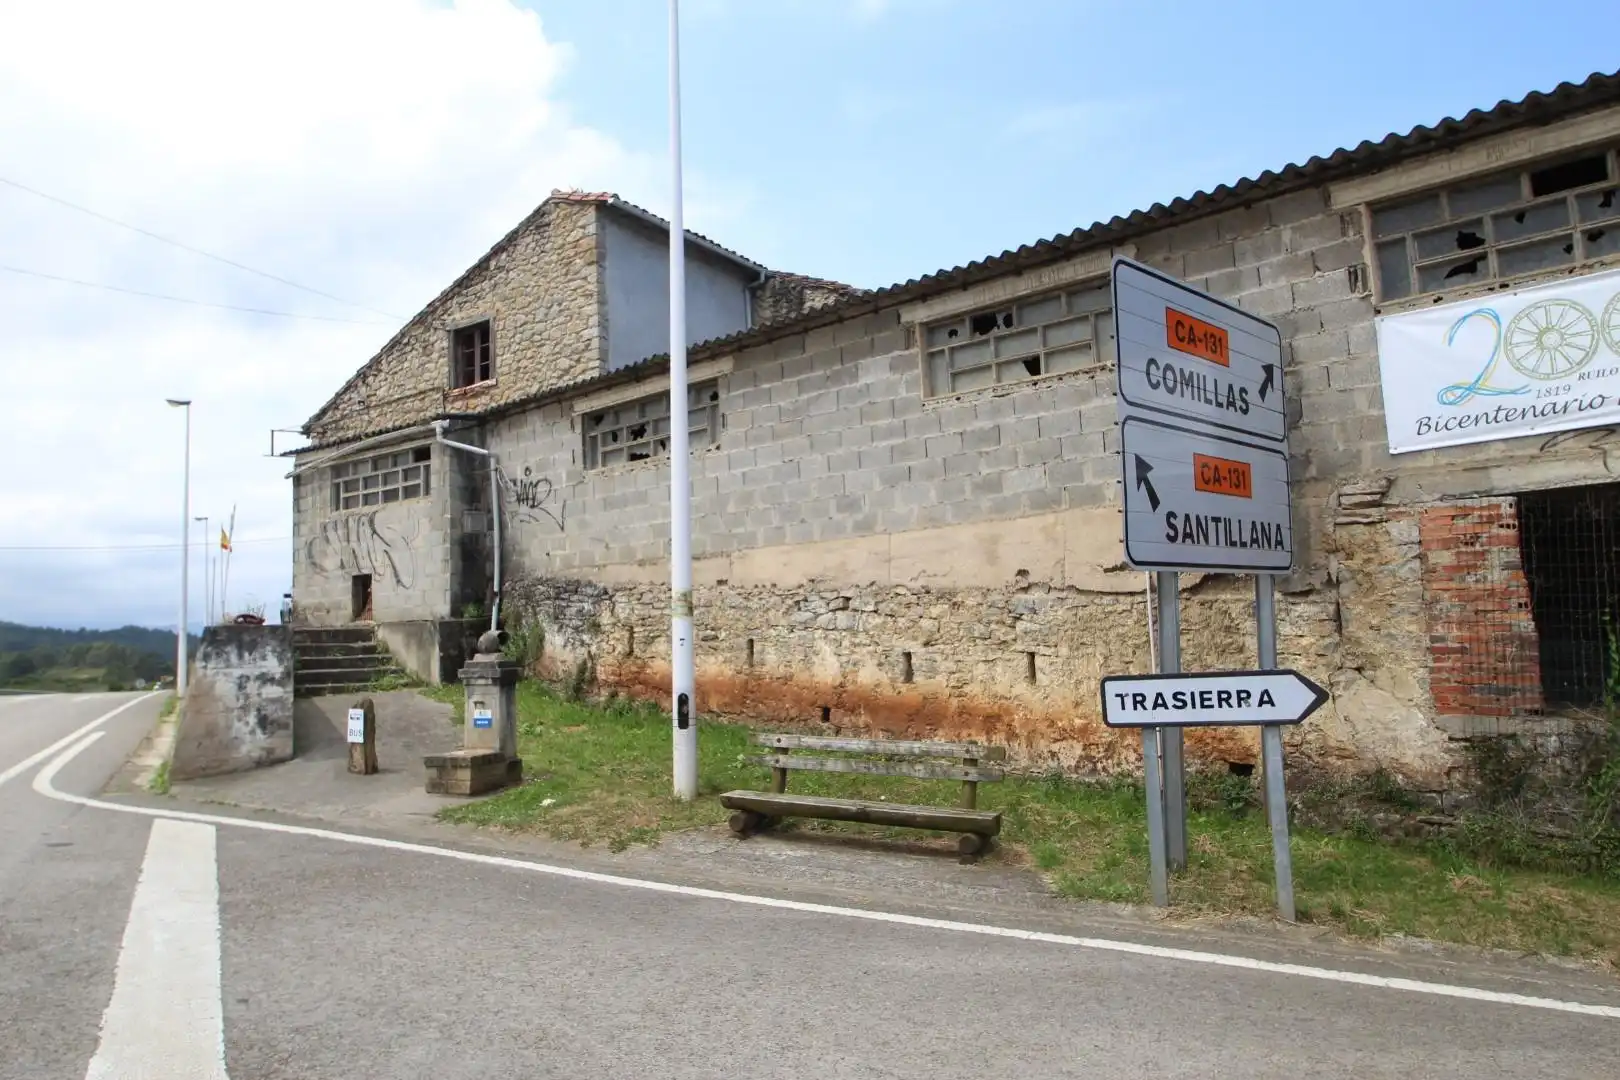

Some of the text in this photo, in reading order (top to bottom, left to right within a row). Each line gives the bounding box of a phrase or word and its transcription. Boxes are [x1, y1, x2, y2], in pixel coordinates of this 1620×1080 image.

[1174, 319, 1224, 357] CA-131
[1145, 357, 1250, 416] COMILLAS
[1535, 383, 1571, 399] 1819
[1415, 394, 1613, 436] Bicentenario
[1199, 461, 1248, 491] CA-131
[1165, 510, 1285, 550] SANTILLANA
[1114, 688, 1276, 711] TRASIERRA
